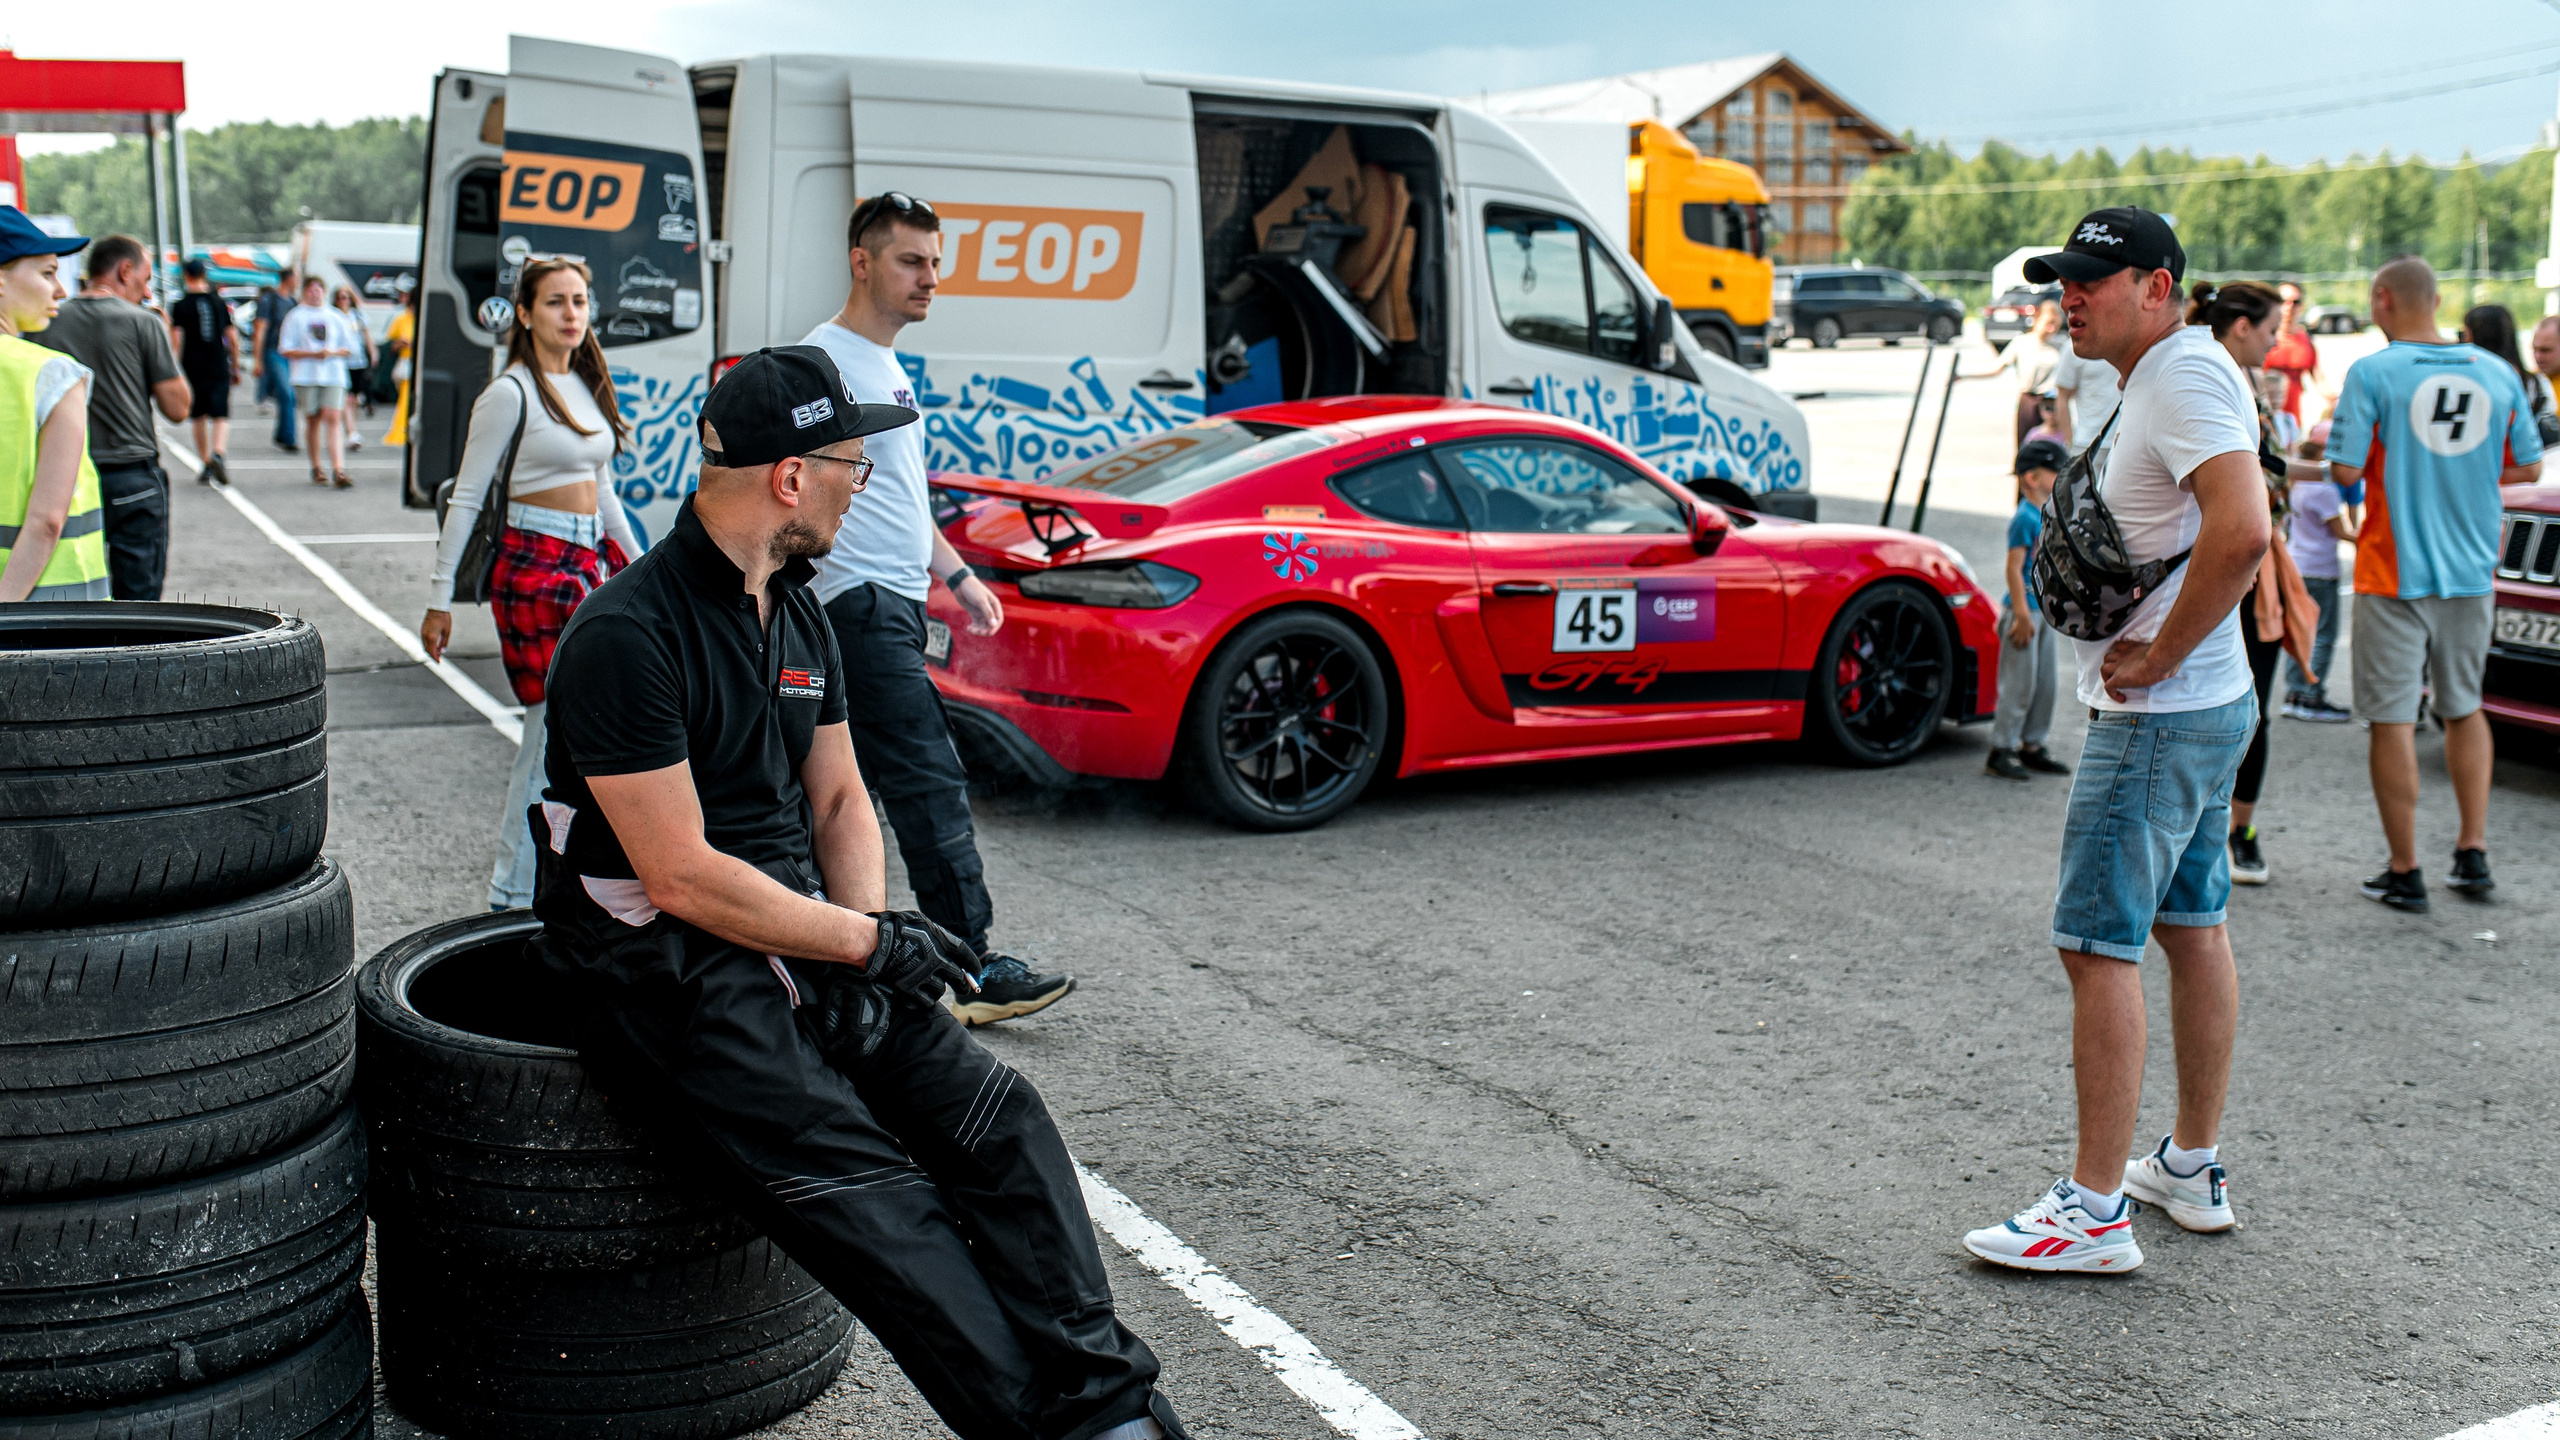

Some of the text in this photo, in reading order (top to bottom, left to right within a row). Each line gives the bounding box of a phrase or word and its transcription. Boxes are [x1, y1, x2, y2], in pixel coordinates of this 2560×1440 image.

[501, 165, 621, 220] ЕОР
[792, 396, 834, 429] 63
[2431, 387, 2472, 441] 4
[1568, 595, 1624, 644] 45
[1528, 655, 1669, 695] GT4
